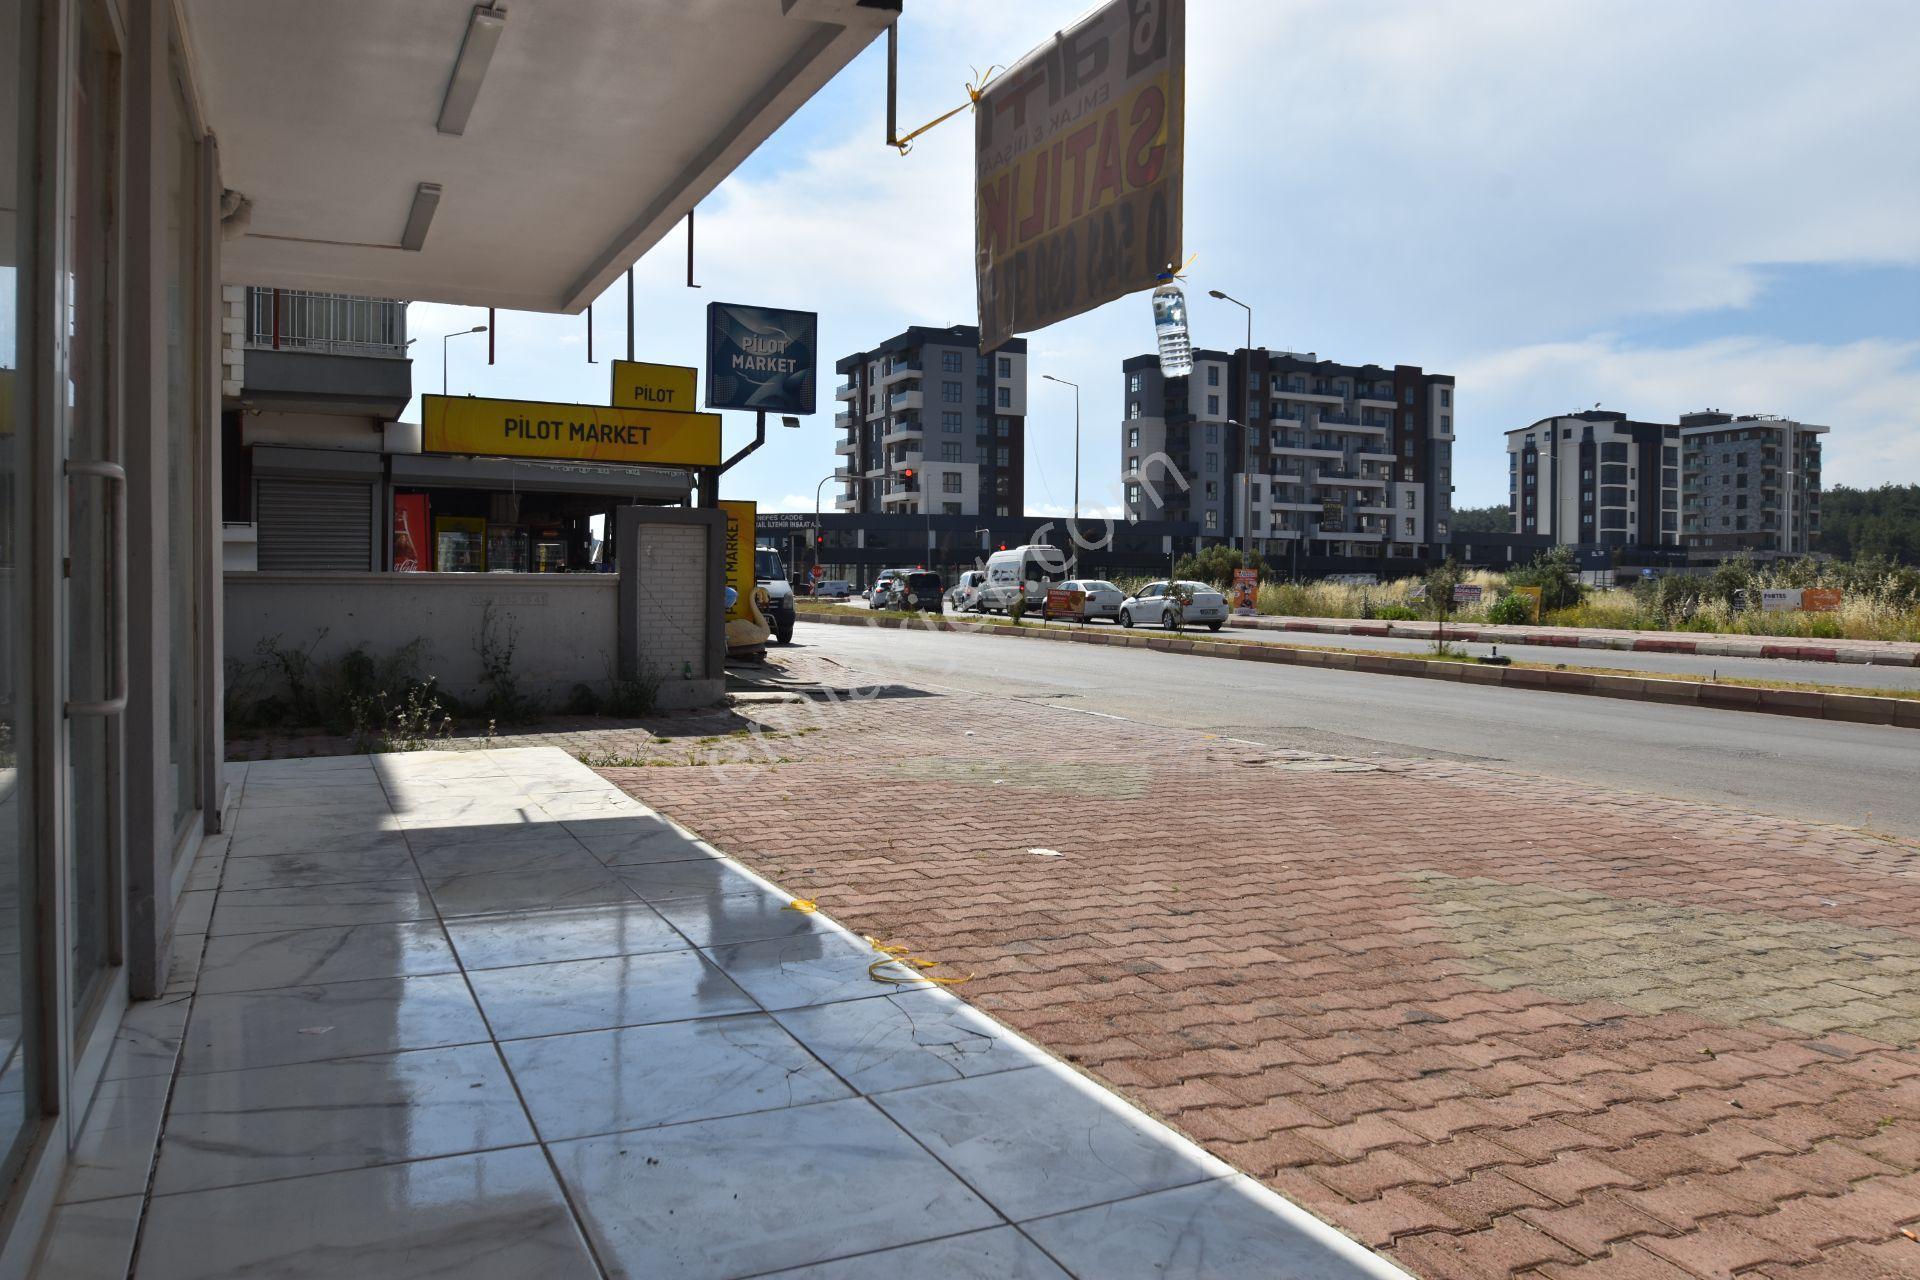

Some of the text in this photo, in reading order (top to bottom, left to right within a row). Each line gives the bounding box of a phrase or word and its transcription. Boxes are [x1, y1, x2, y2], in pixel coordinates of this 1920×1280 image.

[742, 334, 788, 354] PİLOT
[732, 354, 797, 373] MARKET
[634, 384, 675, 403] PİLOT
[504, 414, 652, 446] PİLOT MARKET
